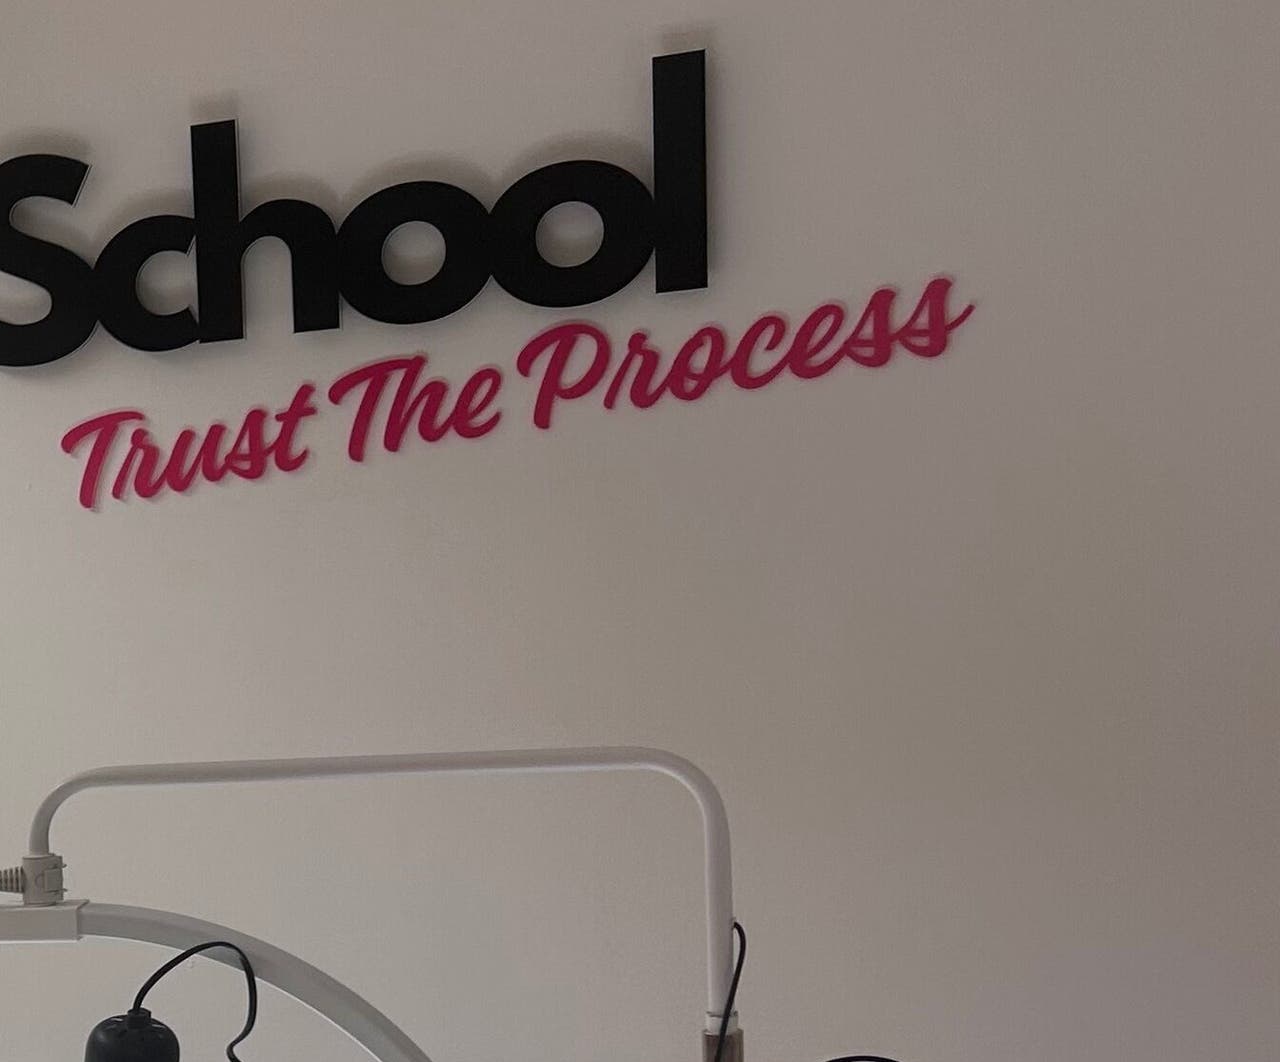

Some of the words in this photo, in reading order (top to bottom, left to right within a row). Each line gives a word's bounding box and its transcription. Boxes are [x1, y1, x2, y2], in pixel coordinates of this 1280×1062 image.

[60, 384, 318, 510] Trust
[327, 355, 503, 464] The
[516, 277, 976, 431] Process
